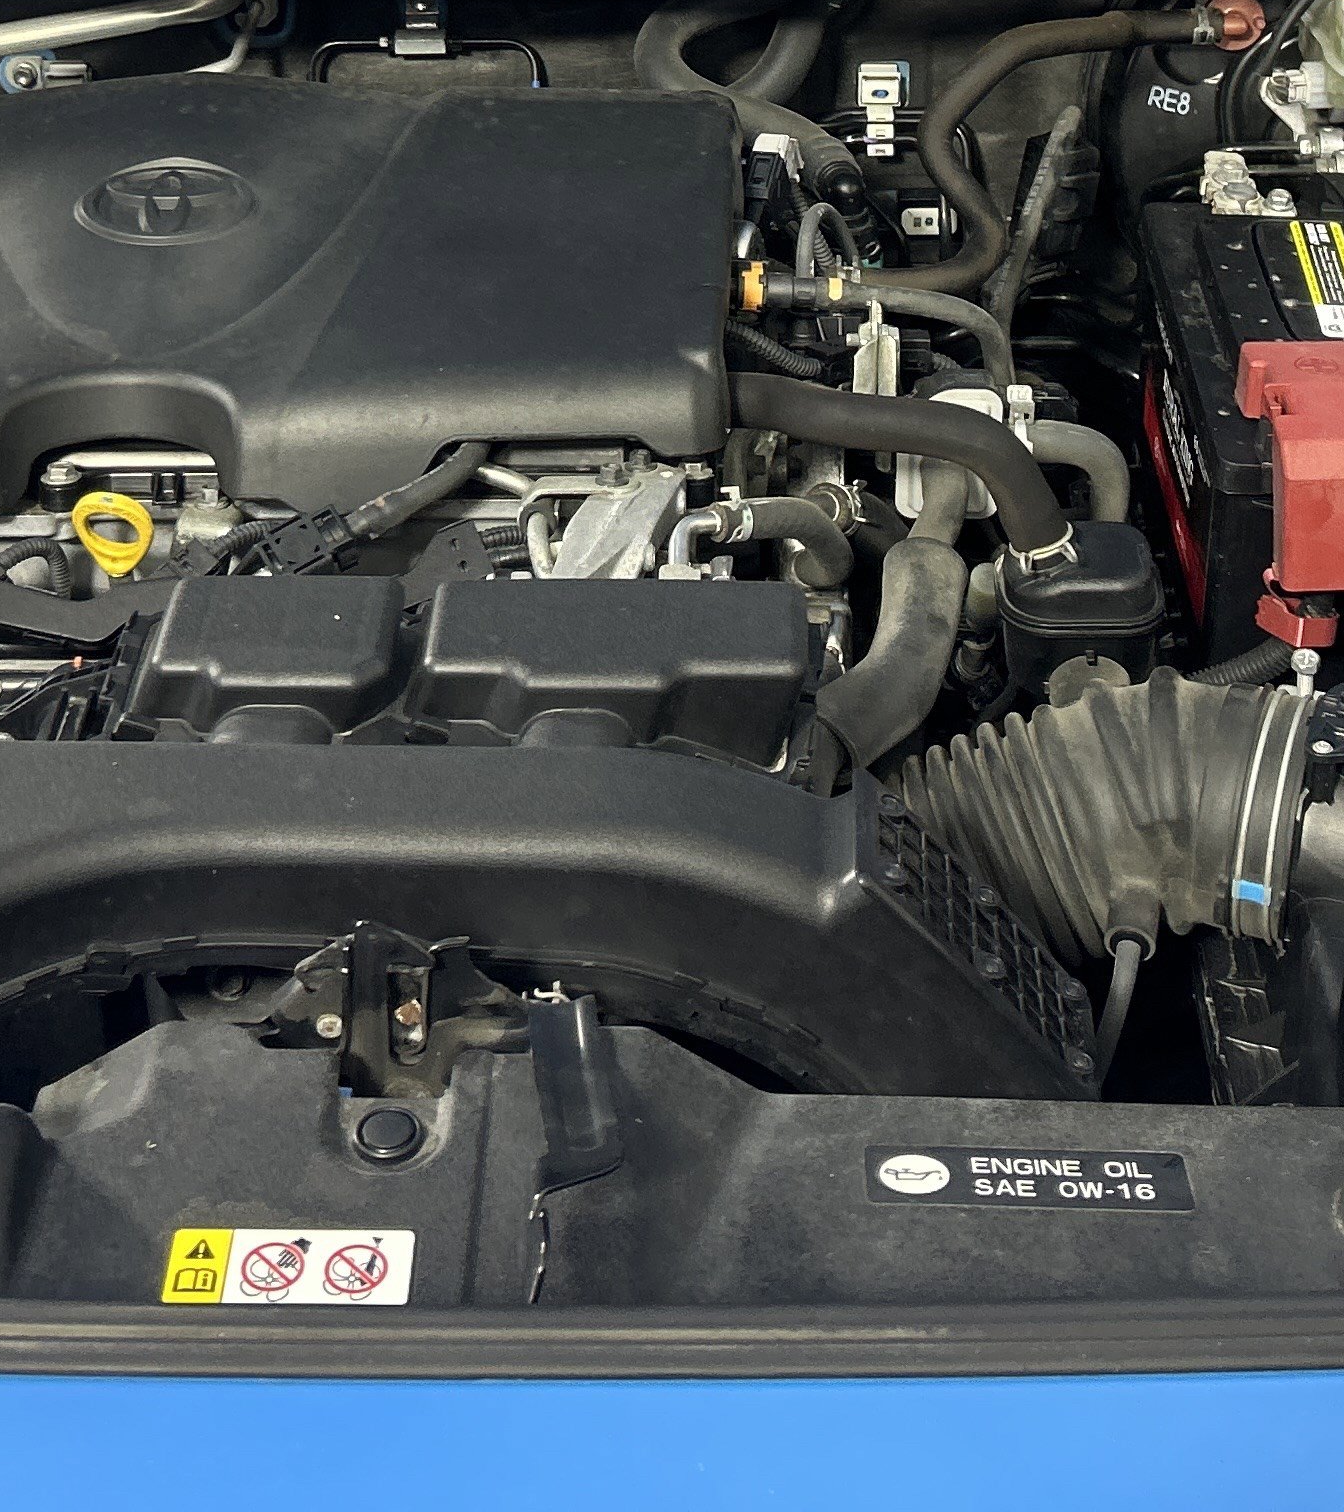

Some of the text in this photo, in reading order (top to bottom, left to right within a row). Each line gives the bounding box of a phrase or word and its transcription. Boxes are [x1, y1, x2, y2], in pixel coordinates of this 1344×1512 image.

[1147, 85, 1191, 115] RE8
[970, 1156, 1153, 1179] ENGINE OIL
[974, 1179, 1156, 1201] SAE 0W-16
